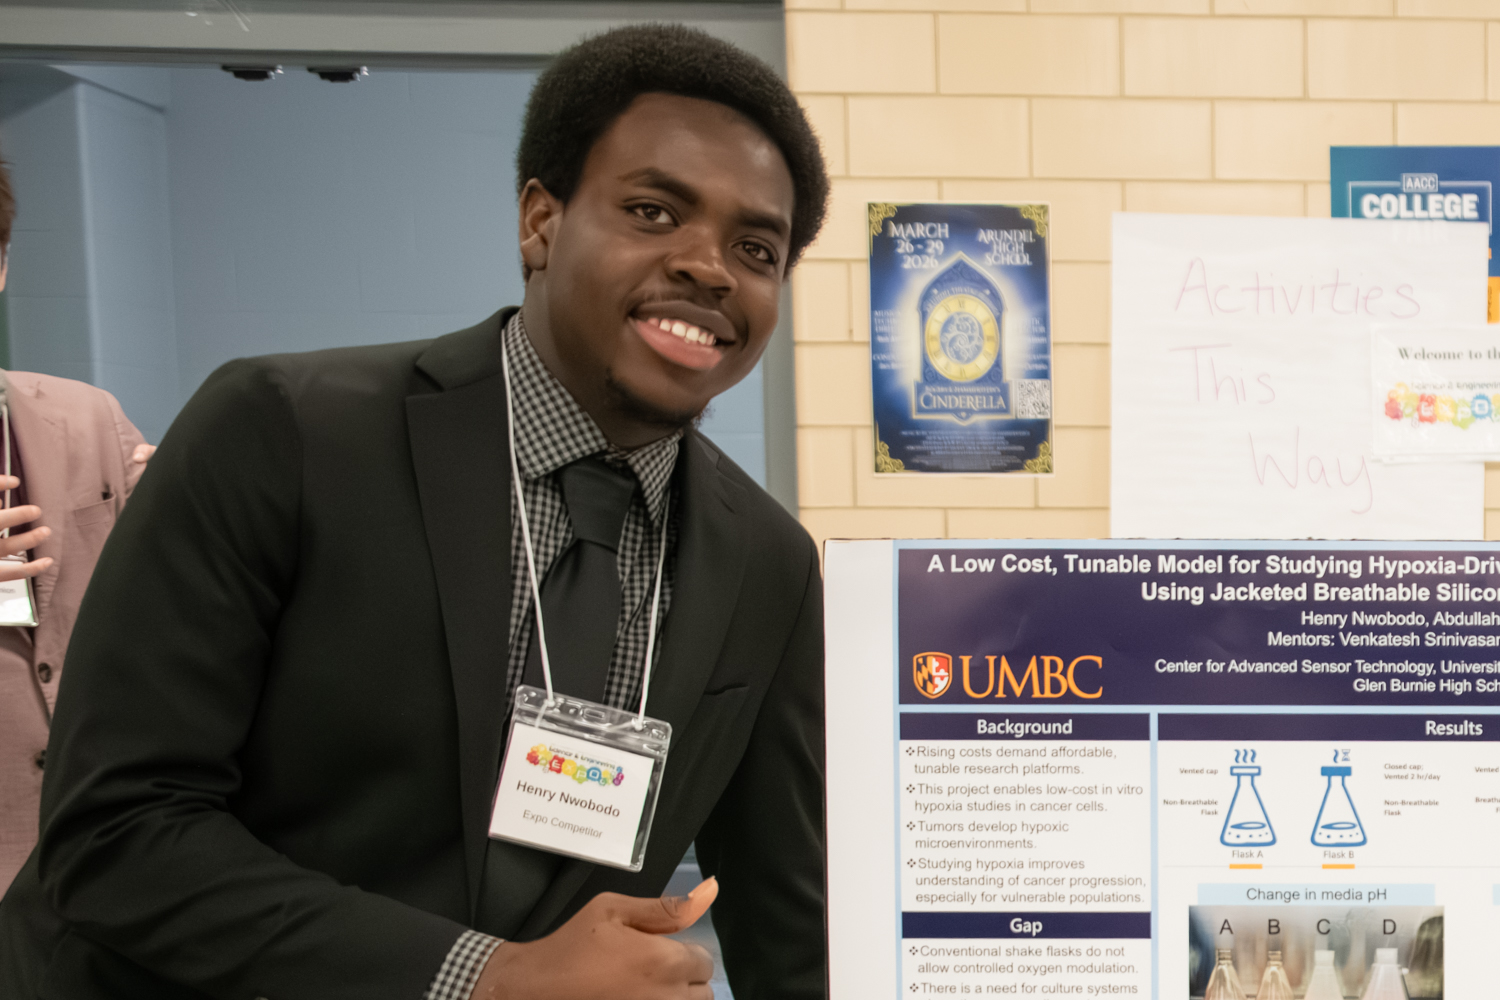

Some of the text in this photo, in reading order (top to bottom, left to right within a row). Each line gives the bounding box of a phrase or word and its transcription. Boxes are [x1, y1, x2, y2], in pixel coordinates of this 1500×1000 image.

[1406, 177, 1436, 189] AACC
[1361, 194, 1479, 219] COLLEGE
[889, 222, 949, 239] MARCH
[977, 229, 1035, 243] ARUNDEL
[896, 240, 914, 253] 26
[927, 240, 944, 253] 29
[993, 242, 1024, 253] HIGH
[903, 255, 938, 269] 2026
[985, 254, 1032, 265] SCHOOL
[1174, 256, 1421, 319] Activities
[1397, 347, 1464, 360] Welcome
[1468, 348, 1482, 360] to
[1169, 342, 1277, 405] This
[920, 393, 1006, 410] CINDERELLA
[1249, 426, 1373, 514] Way
[927, 553, 945, 573] A
[950, 554, 996, 573] Low
[1001, 553, 1058, 576] Cost,
[1063, 553, 1152, 574] Tunable
[1158, 554, 1223, 574] Model
[1228, 554, 1261, 574] for
[1266, 554, 1362, 579] Studying
[1141, 582, 1204, 606] Using
[1209, 582, 1307, 602] Jacketed
[1313, 582, 1431, 602] Breathable
[1301, 610, 1349, 630] Henry
[1351, 610, 1430, 628] Nwobodo,
[1432, 610, 1500, 627] Abdullah
[1267, 630, 1335, 647] Mentors:
[1339, 631, 1420, 647] Venkatesh
[958, 654, 1104, 699] UMBC
[1154, 658, 1204, 674] Center
[1205, 658, 1226, 674] for
[1227, 658, 1298, 674] Advanced
[1301, 658, 1352, 674] Sensor
[1354, 659, 1437, 680] Technology,
[1353, 677, 1387, 693] Glen
[1390, 678, 1436, 693] Burnie
[1439, 678, 1472, 696] High
[976, 718, 1073, 739] Background
[1424, 719, 1484, 736] Results
[916, 745, 1117, 761] Rising costs demand affordable,
[913, 762, 1084, 777] tunable research platforms.
[516, 780, 620, 817] Henry Nwobodo
[523, 809, 603, 839] Expo Competitor
[1232, 850, 1263, 858] Flask A
[1323, 850, 1354, 859] Flask B
[1245, 887, 1387, 904] Change in media pH
[1009, 917, 1044, 937] Gap
[1218, 918, 1235, 935] A
[1267, 918, 1281, 936] B
[1316, 918, 1334, 936] C
[1382, 918, 1397, 936] D
